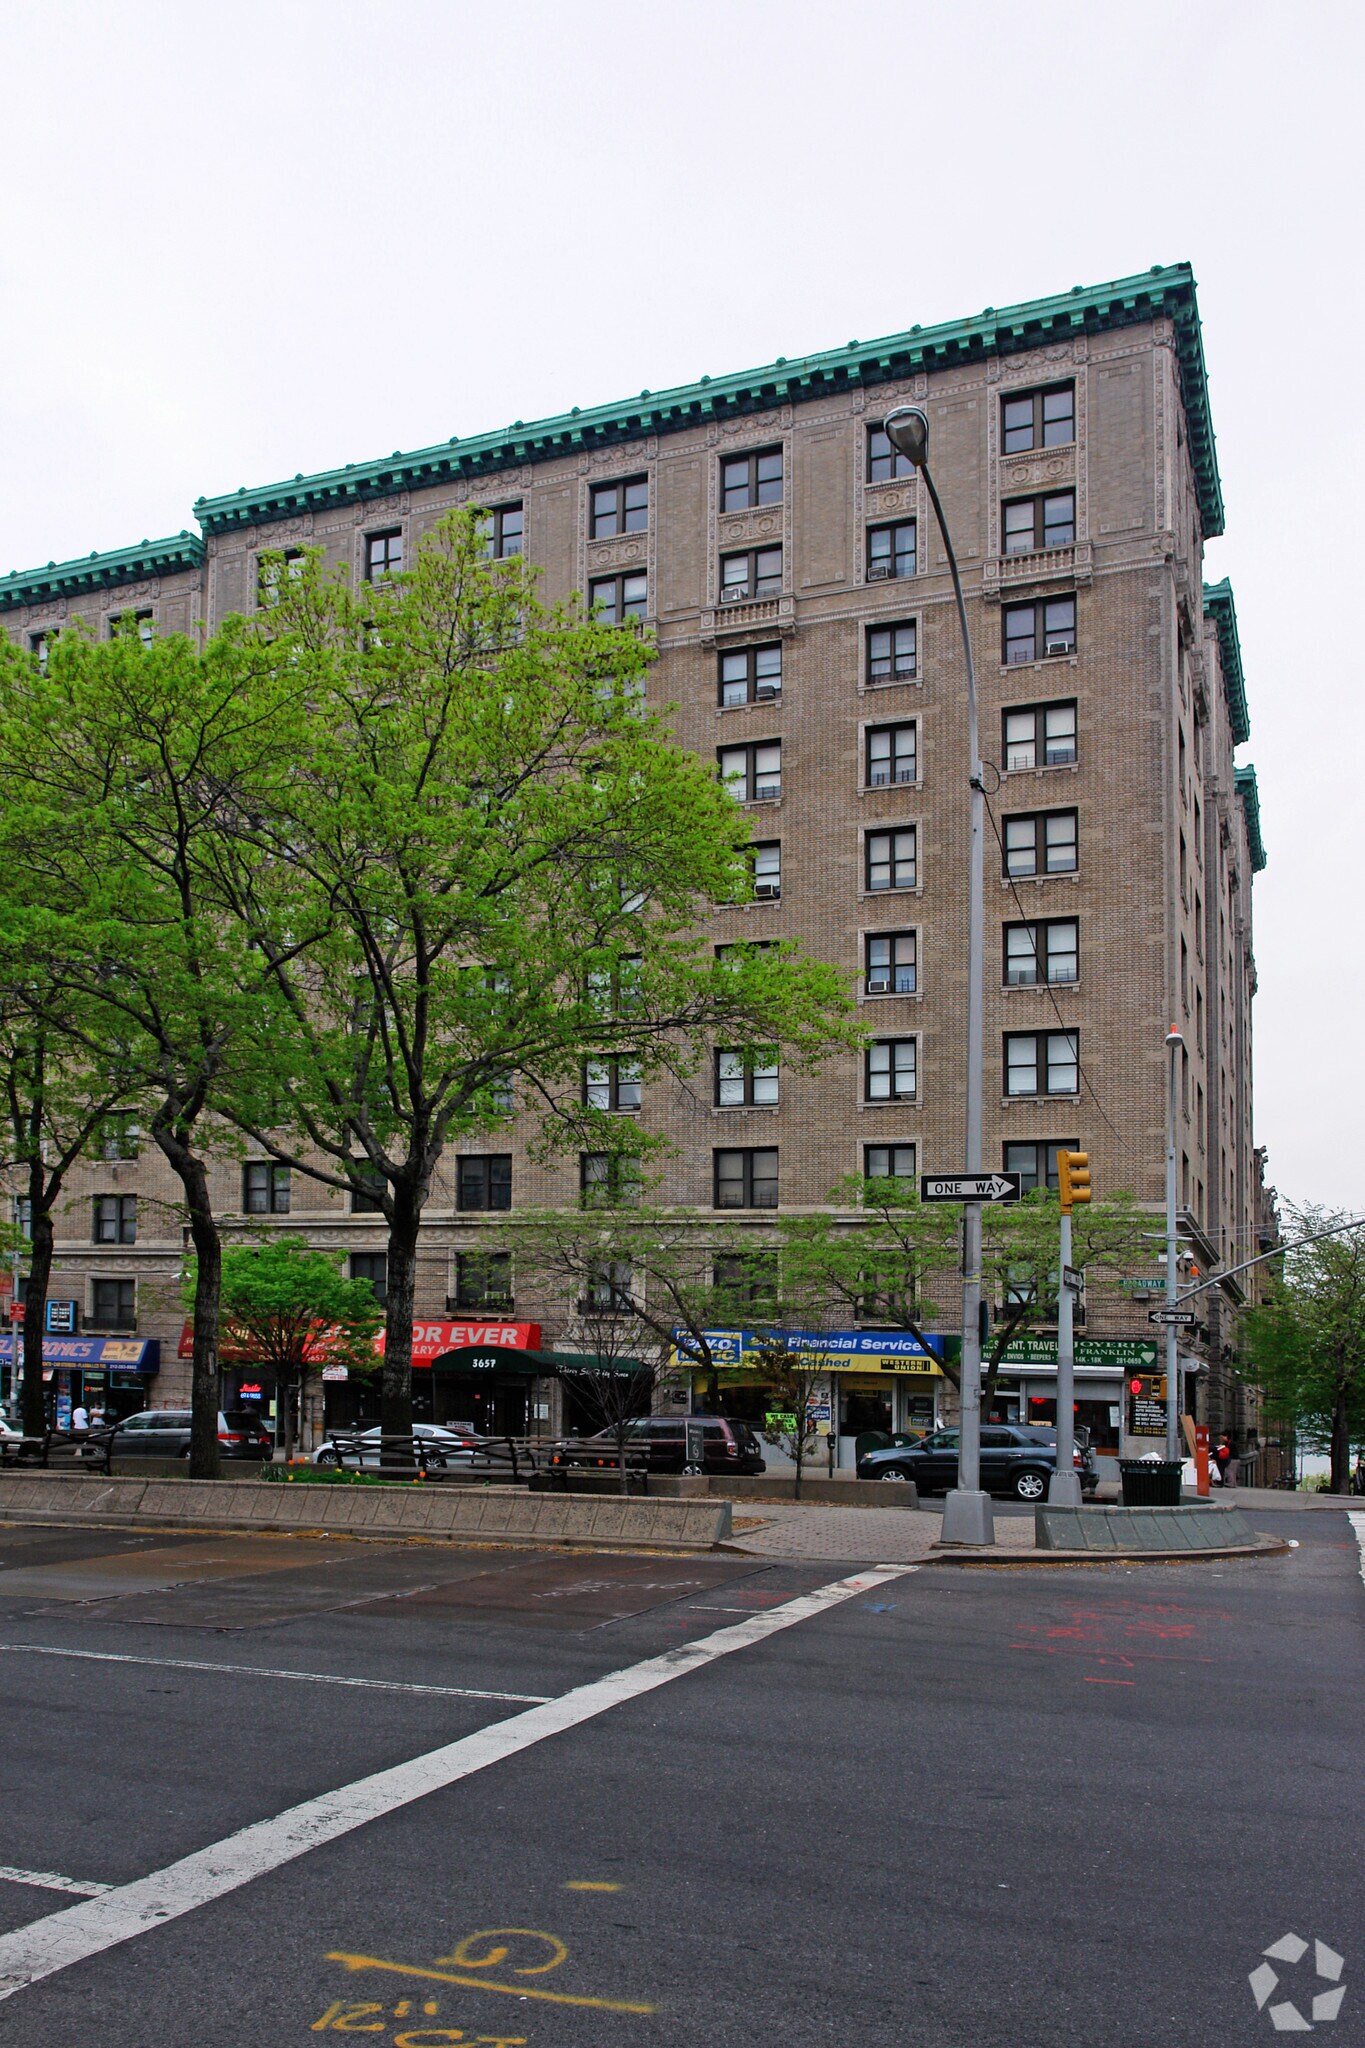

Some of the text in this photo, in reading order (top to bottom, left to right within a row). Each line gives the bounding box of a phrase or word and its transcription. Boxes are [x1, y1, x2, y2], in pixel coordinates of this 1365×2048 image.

[934, 1182, 1004, 1194] ONE WAY
[412, 1326, 518, 1345] OR EVER
[787, 1337, 857, 1349] Financial
[1074, 1341, 1149, 1349] JOYERIA
[472, 1359, 496, 1368] 3657
[800, 1357, 851, 1367] Cashed
